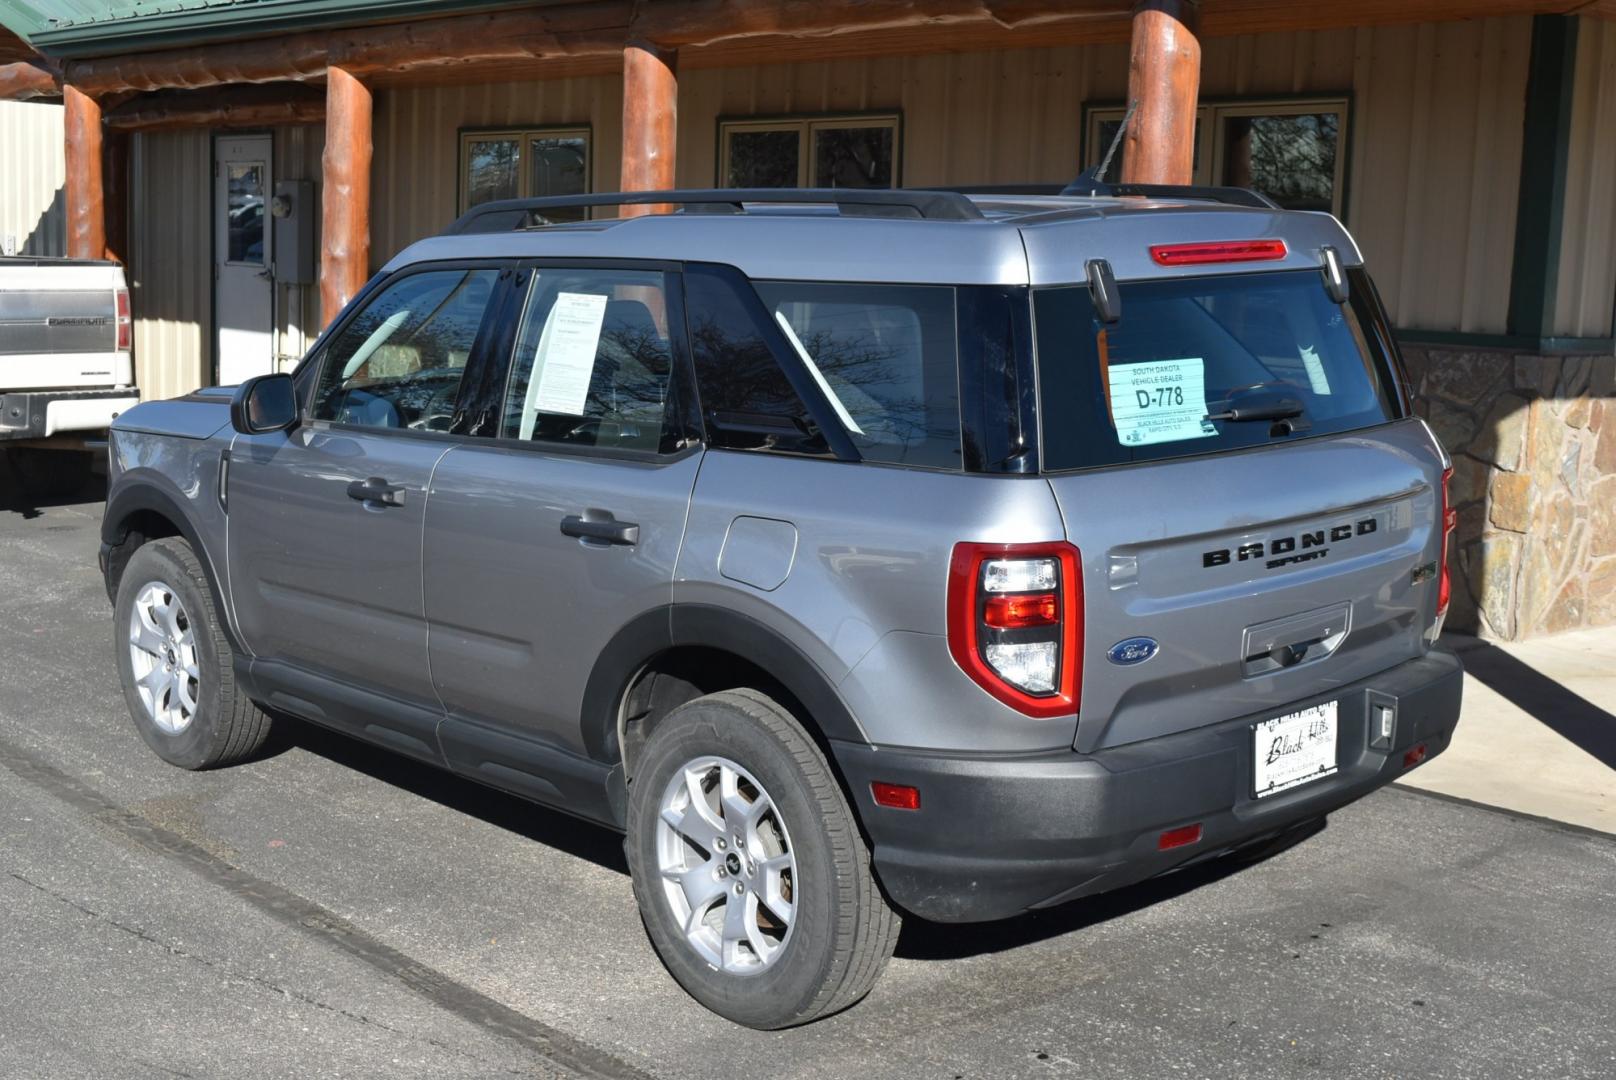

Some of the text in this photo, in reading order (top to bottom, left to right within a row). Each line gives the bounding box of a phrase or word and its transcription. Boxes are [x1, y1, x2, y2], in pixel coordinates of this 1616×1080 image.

[1131, 374, 1183, 386] VEHICLE DEALER
[1132, 364, 1180, 376] SOUTH DAKOTA
[1135, 386, 1184, 409] D-778
[1203, 518, 1377, 568] BRONCO
[1266, 548, 1330, 569] SPORT
[1256, 718, 1280, 731] BLACK
[1280, 711, 1300, 724] HILLS
[1266, 730, 1303, 766] Black
